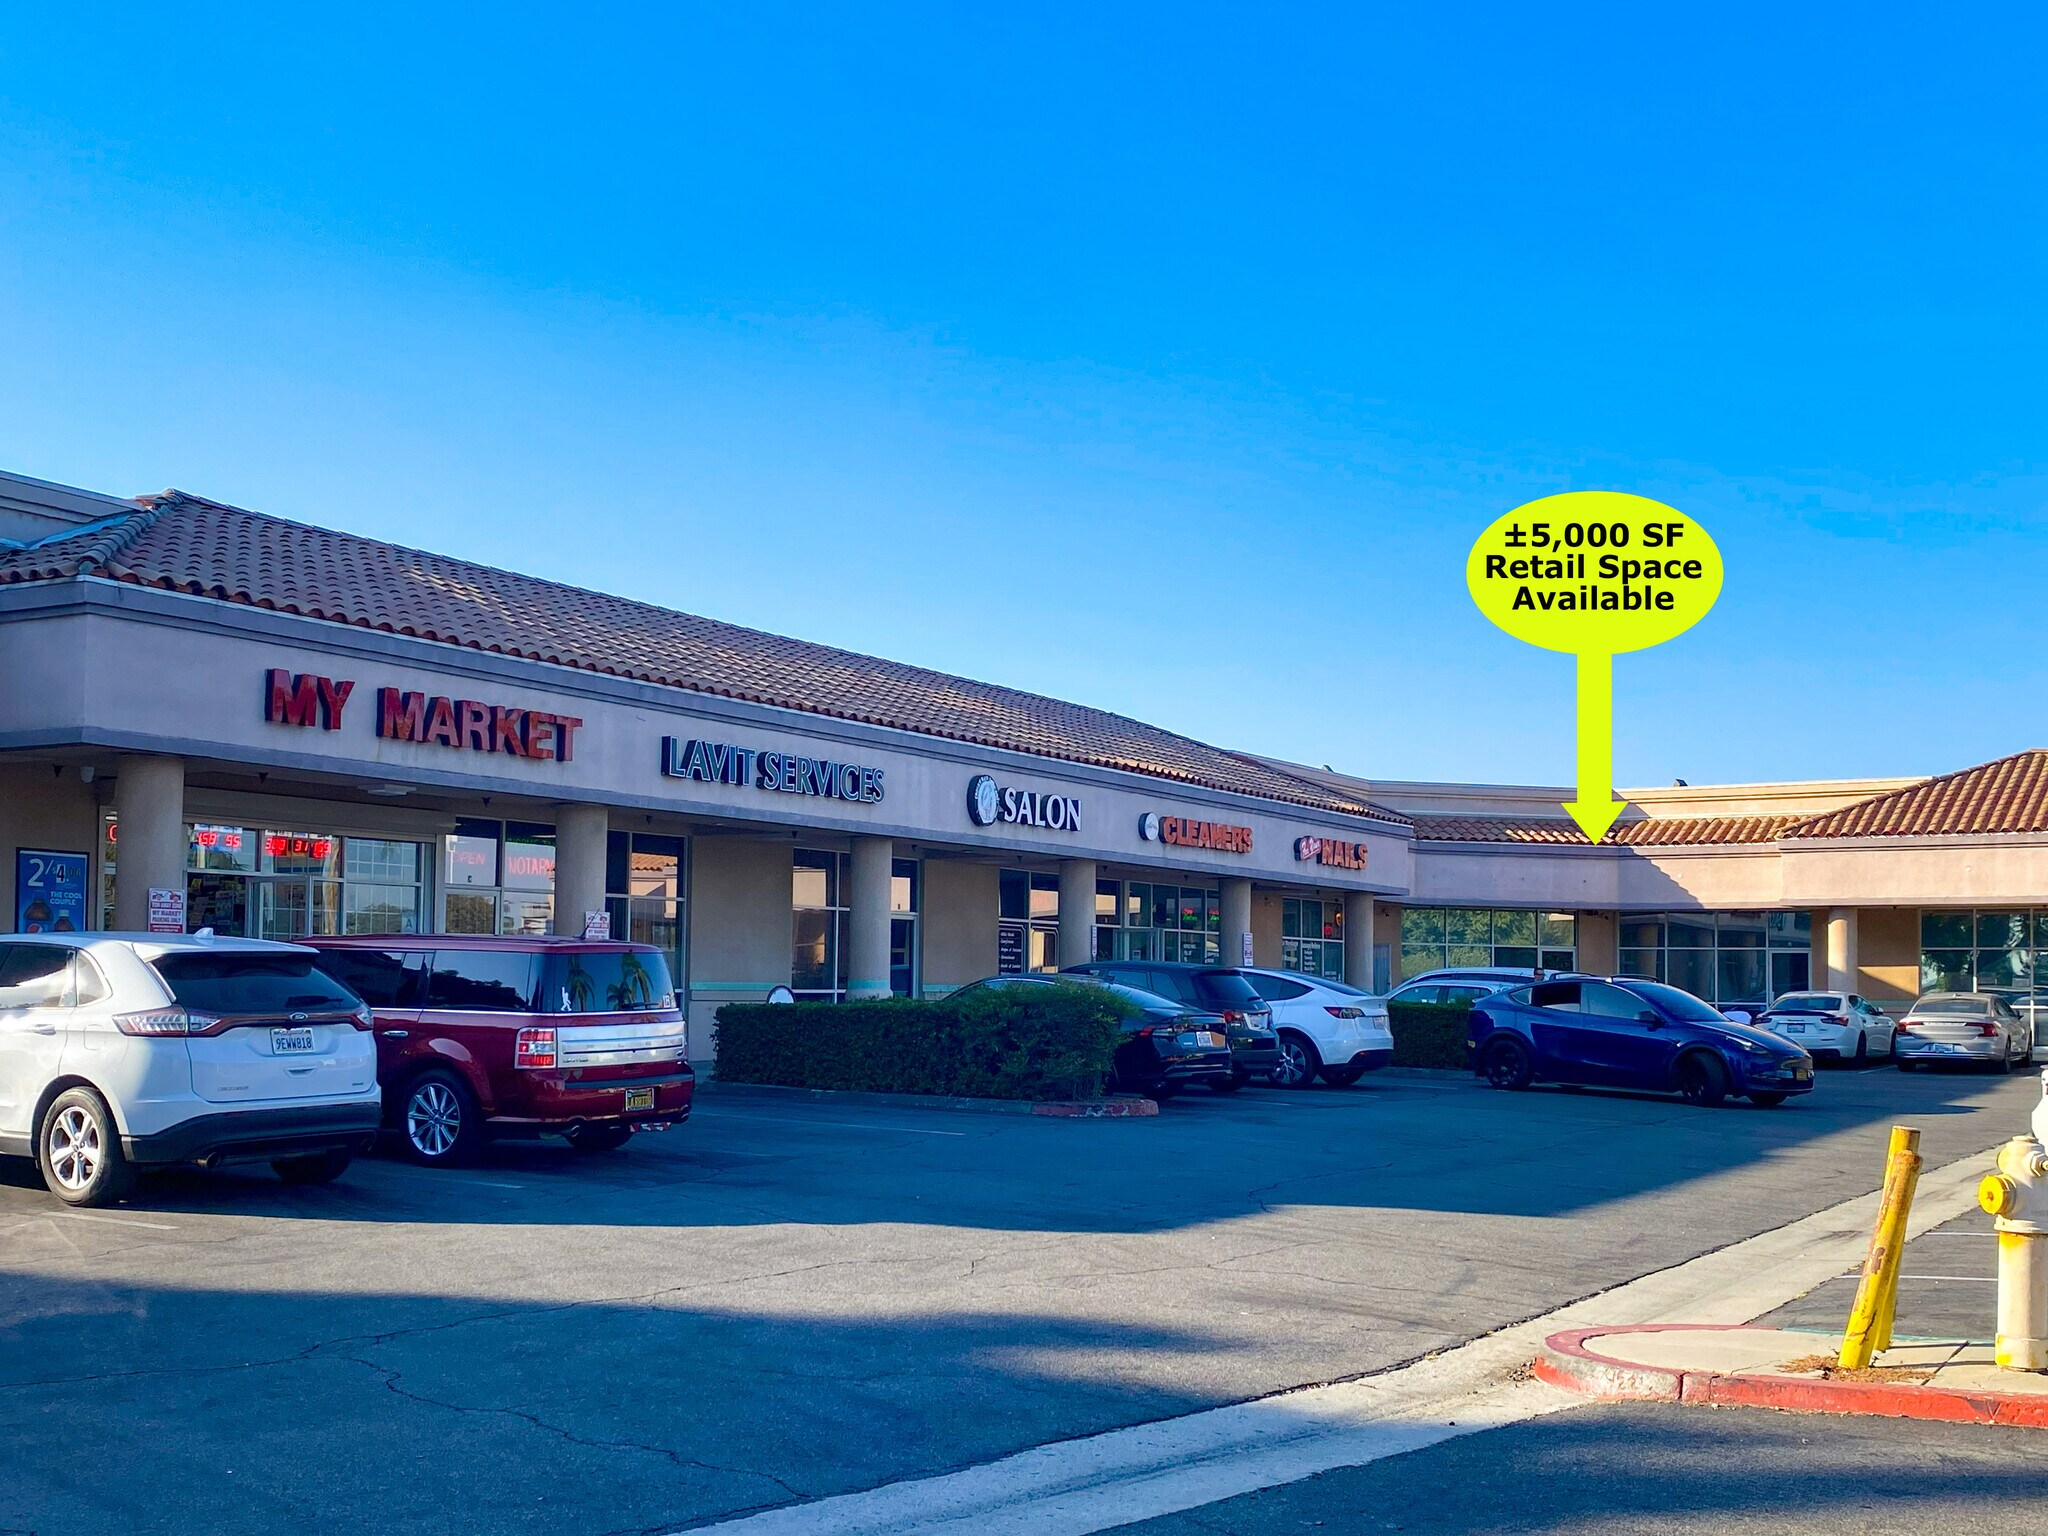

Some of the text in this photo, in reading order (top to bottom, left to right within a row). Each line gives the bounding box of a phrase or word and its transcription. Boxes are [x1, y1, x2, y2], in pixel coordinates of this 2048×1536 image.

[264, 668, 583, 762] MY MARKET
[661, 735, 885, 804] LAVIT SERVICES
[1000, 786, 1082, 832] SALON
[1159, 816, 1253, 854] CLEANERS
[453, 850, 485, 865] OPEN
[1318, 837, 1368, 870] NAILS
[50, 898, 77, 906] COUPLE
[405, 918, 413, 929] A
